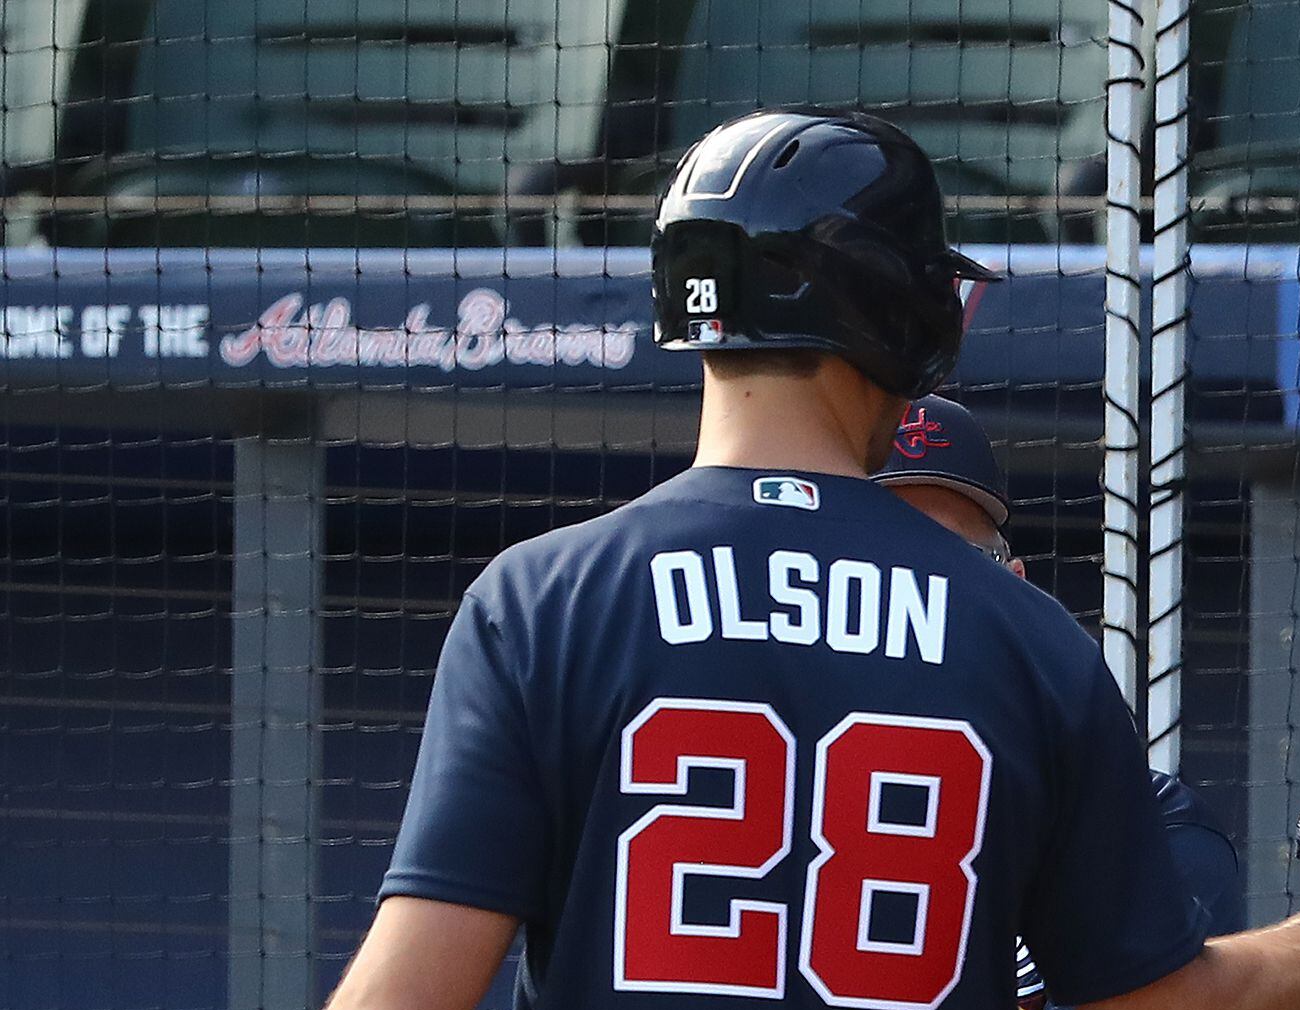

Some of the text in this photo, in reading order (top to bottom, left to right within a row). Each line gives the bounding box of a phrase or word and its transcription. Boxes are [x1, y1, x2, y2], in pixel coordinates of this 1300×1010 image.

[685, 278, 718, 313] 28
[0, 304, 74, 359] ME
[81, 304, 131, 358] OF
[138, 303, 210, 358] THE
[650, 546, 949, 664] OLSON
